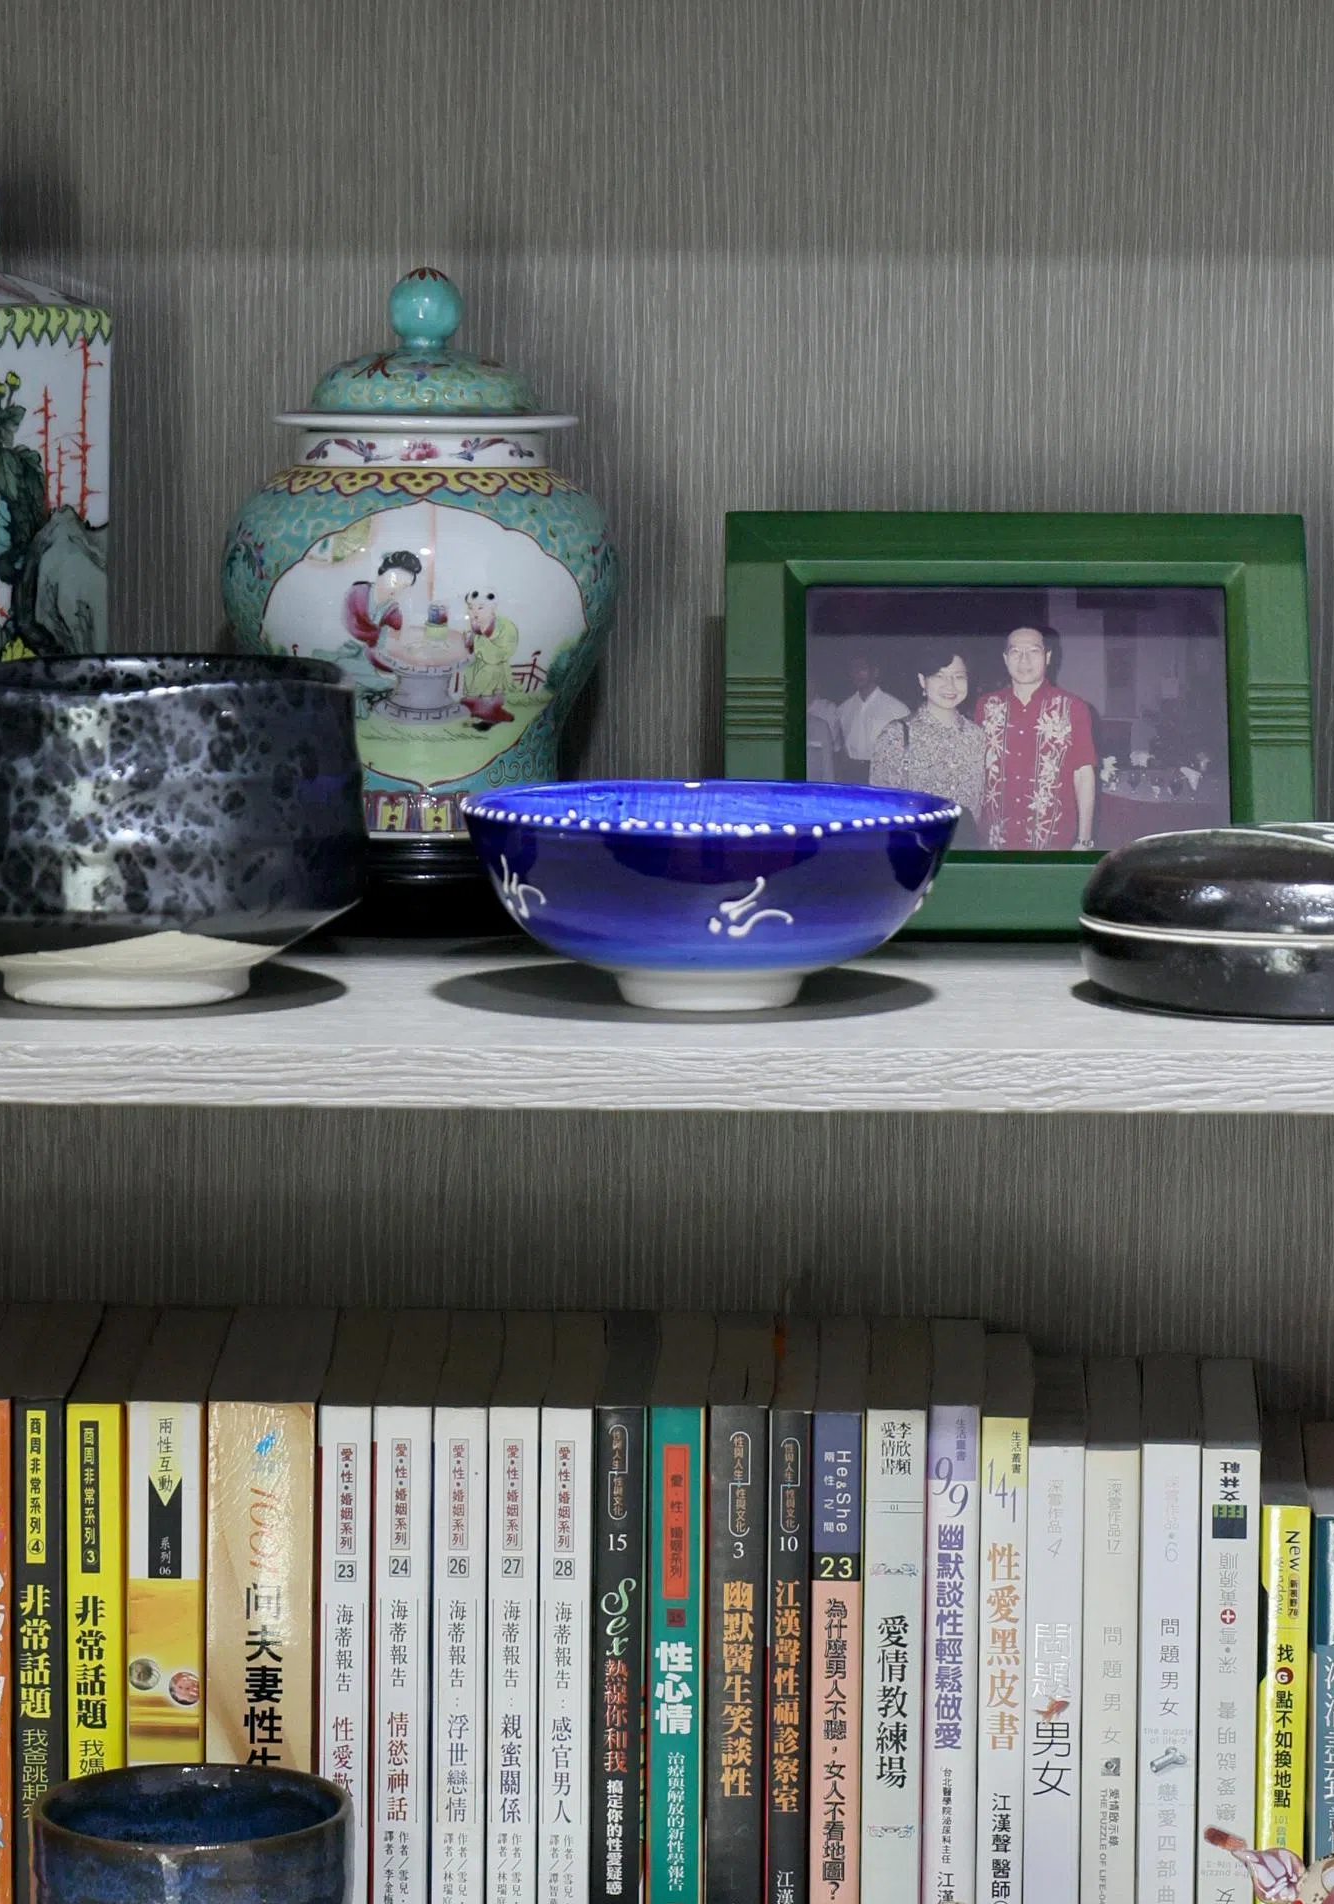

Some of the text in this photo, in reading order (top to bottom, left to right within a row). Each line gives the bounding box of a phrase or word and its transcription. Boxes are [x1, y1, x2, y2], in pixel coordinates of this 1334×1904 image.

[156, 1416, 176, 1494] 兩性互動
[897, 1422, 912, 1475] 李欣頻
[932, 1457, 969, 1518] 99
[338, 1563, 355, 1579] 23
[391, 1558, 408, 1575] 24
[449, 1558, 467, 1575] 26
[503, 1558, 521, 1575] 27
[555, 1560, 573, 1577] 28
[607, 1533, 628, 1552] 15
[732, 1541, 745, 1559] 3
[778, 1536, 799, 1553] 10
[819, 1556, 853, 1579] 23
[1285, 1530, 1300, 1572] New
[20, 1583, 51, 1720] 非常話題
[75, 1594, 108, 1730] 非常話題
[335, 1603, 354, 1693] 海蒂報告
[934, 1524, 966, 1750] 幽默談性輕鬆做愛
[986, 1542, 1021, 1751] 性愛黑皮書
[1159, 1618, 1180, 1717] 問題男女
[387, 1599, 409, 1822] 海蒂報告 情慾神話
[654, 1640, 693, 1736] 性心情
[721, 1580, 755, 1798] 幽默醫生笑談性
[773, 1580, 801, 1813] 江漢聲性福診察室
[875, 1615, 909, 1789] 愛情教練場
[1102, 1624, 1123, 1746] 問題男女
[606, 1779, 623, 1895] 搞定你的性愛疑惑
[666, 1751, 685, 1891] 治療與解放的新性學報告
[1098, 1788, 1108, 1809] THE
[1098, 1811, 1108, 1851] PUZZLE
[1098, 1852, 1107, 1867] OF
[1156, 1784, 1179, 1904] 戀愛四部曲
